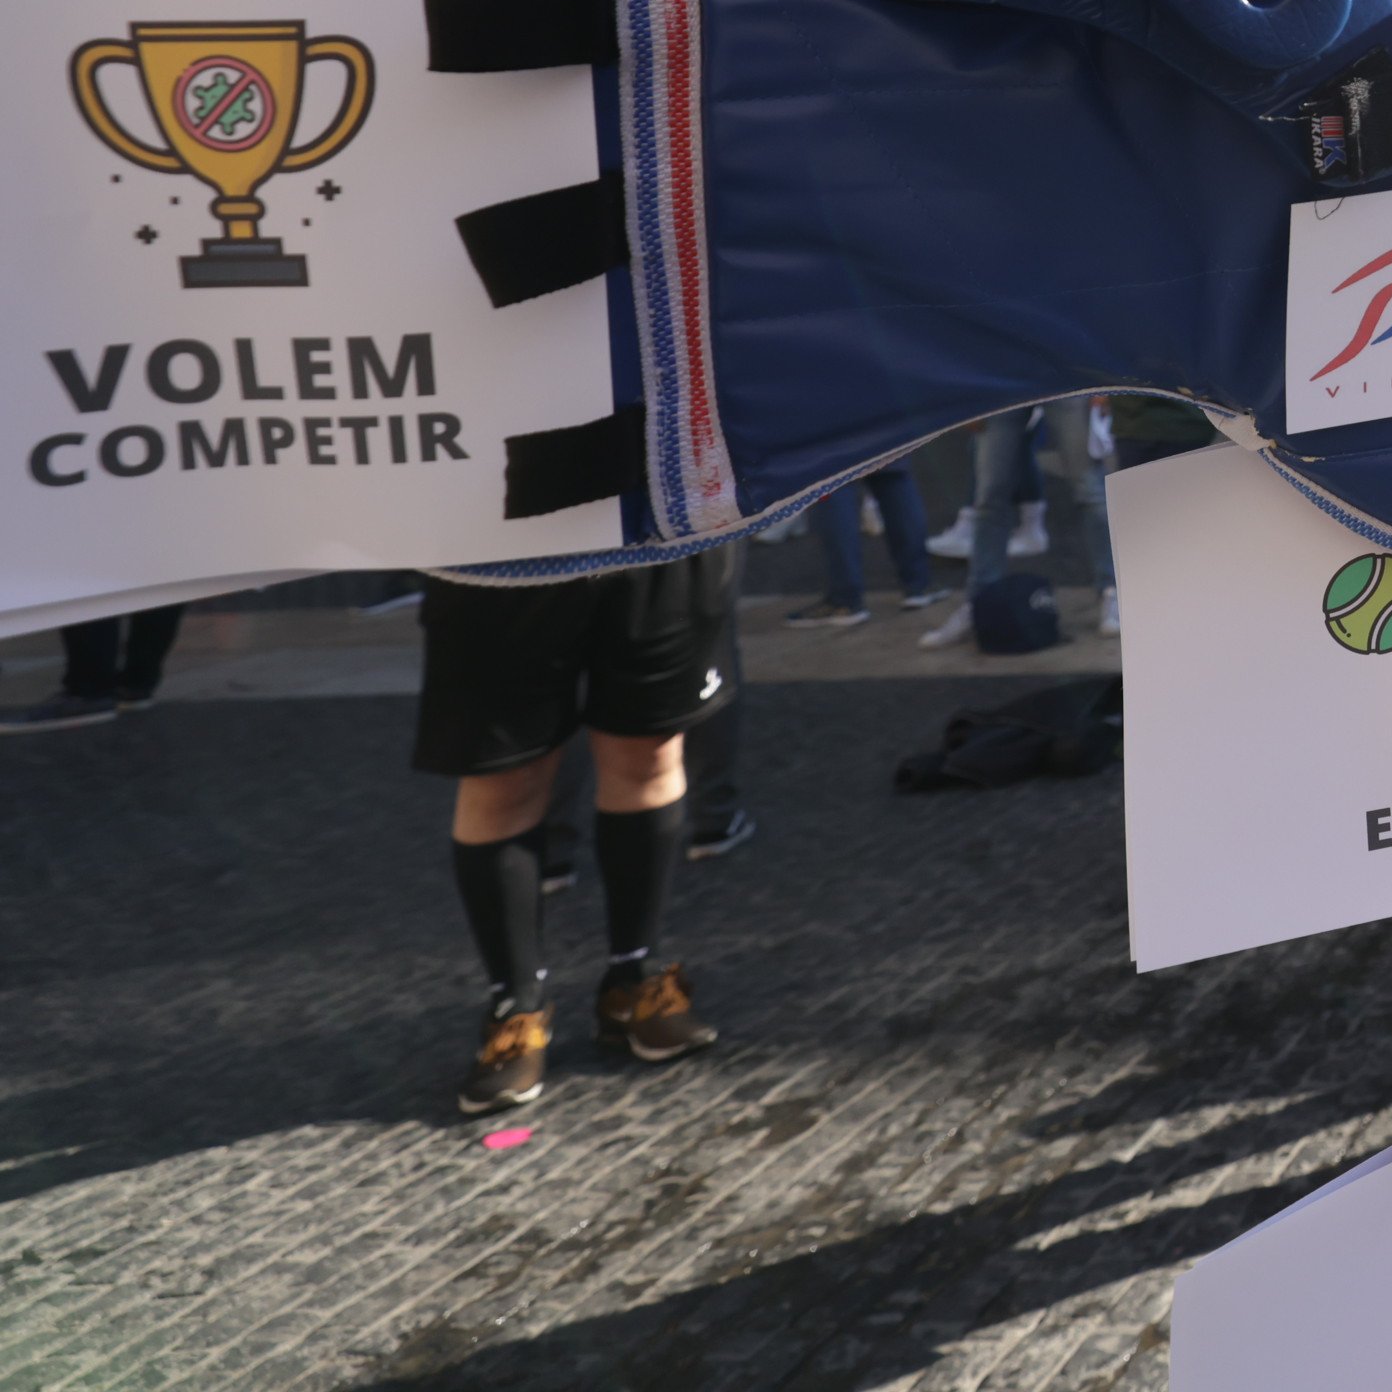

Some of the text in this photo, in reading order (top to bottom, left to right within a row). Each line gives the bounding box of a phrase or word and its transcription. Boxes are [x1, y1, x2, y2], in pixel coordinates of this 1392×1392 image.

[1310, 116, 1324, 169] IKARA
[45, 332, 437, 414] VOLEM
[27, 411, 471, 488] COMPETIR
